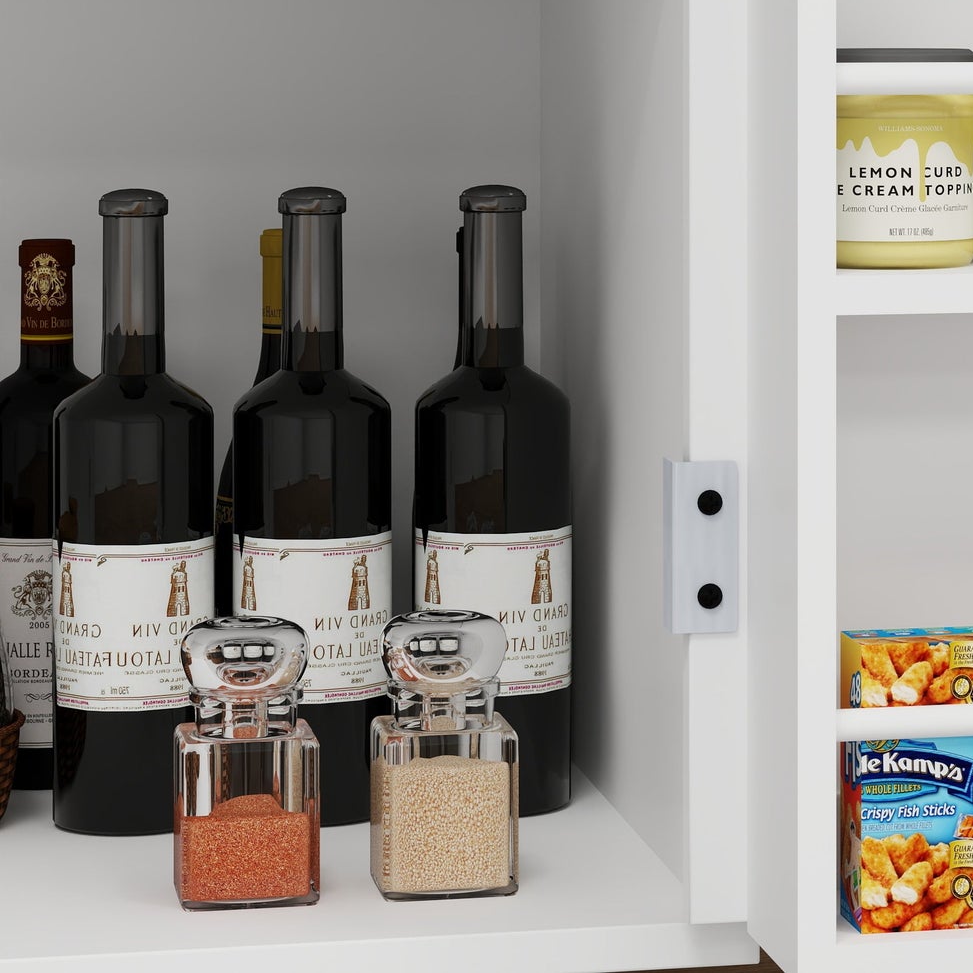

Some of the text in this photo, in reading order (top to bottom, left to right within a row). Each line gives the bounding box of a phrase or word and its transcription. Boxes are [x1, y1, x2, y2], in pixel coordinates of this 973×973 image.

[849, 166, 962, 178] LEMON CURD
[852, 184, 914, 197] CREAM
[842, 204, 869, 213] Lemon
[869, 204, 888, 213] Curd
[29, 621, 50, 629] 2005
[882, 751, 964, 785] Kamp's
[866, 784, 921, 795] WHOLE FILLETS
[861, 802, 956, 821] Crispy Fish Sticks
